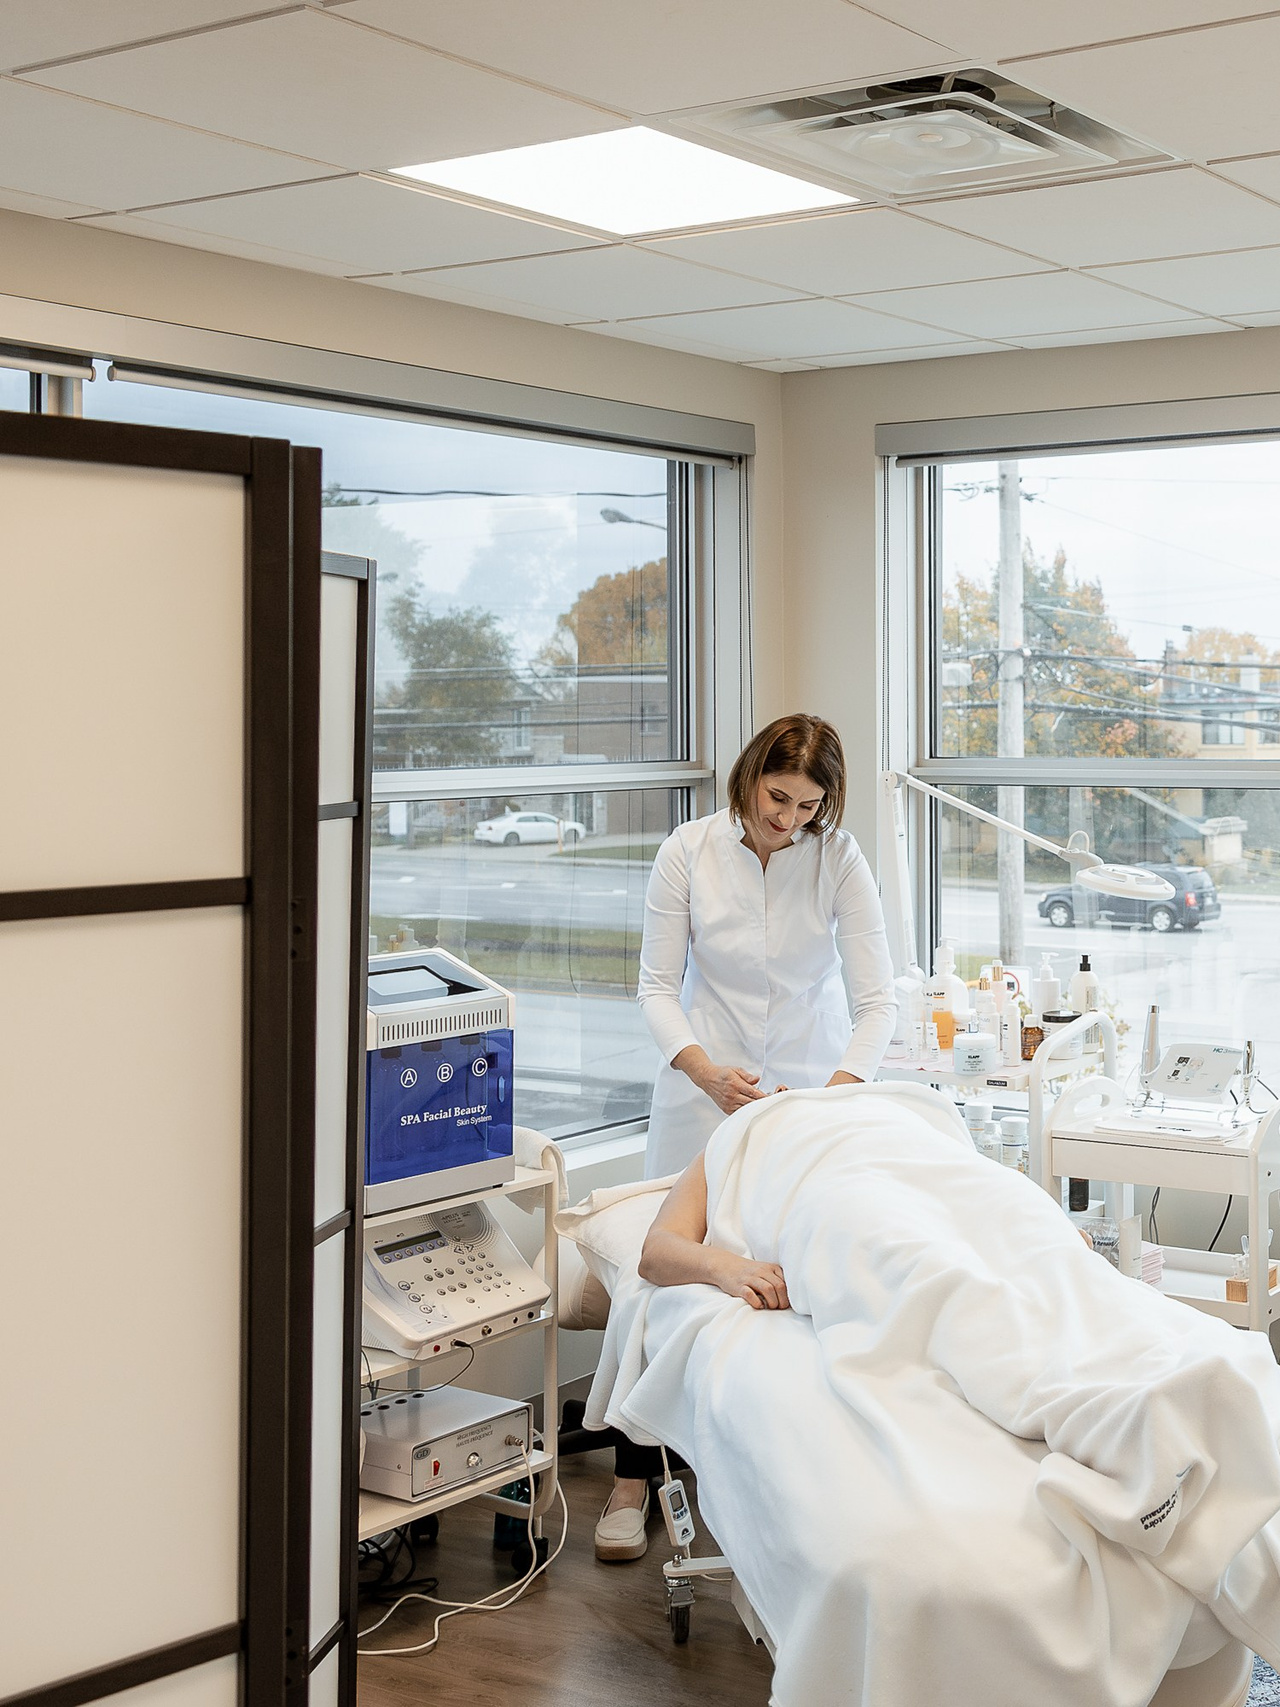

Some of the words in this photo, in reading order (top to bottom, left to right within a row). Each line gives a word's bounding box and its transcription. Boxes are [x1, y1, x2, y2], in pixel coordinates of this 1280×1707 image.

[401, 1114, 421, 1126] SPA
[423, 1108, 452, 1122] Facial
[454, 1104, 487, 1118] Beauty
[456, 1118, 470, 1127] Skin
[470, 1115, 492, 1125] System
